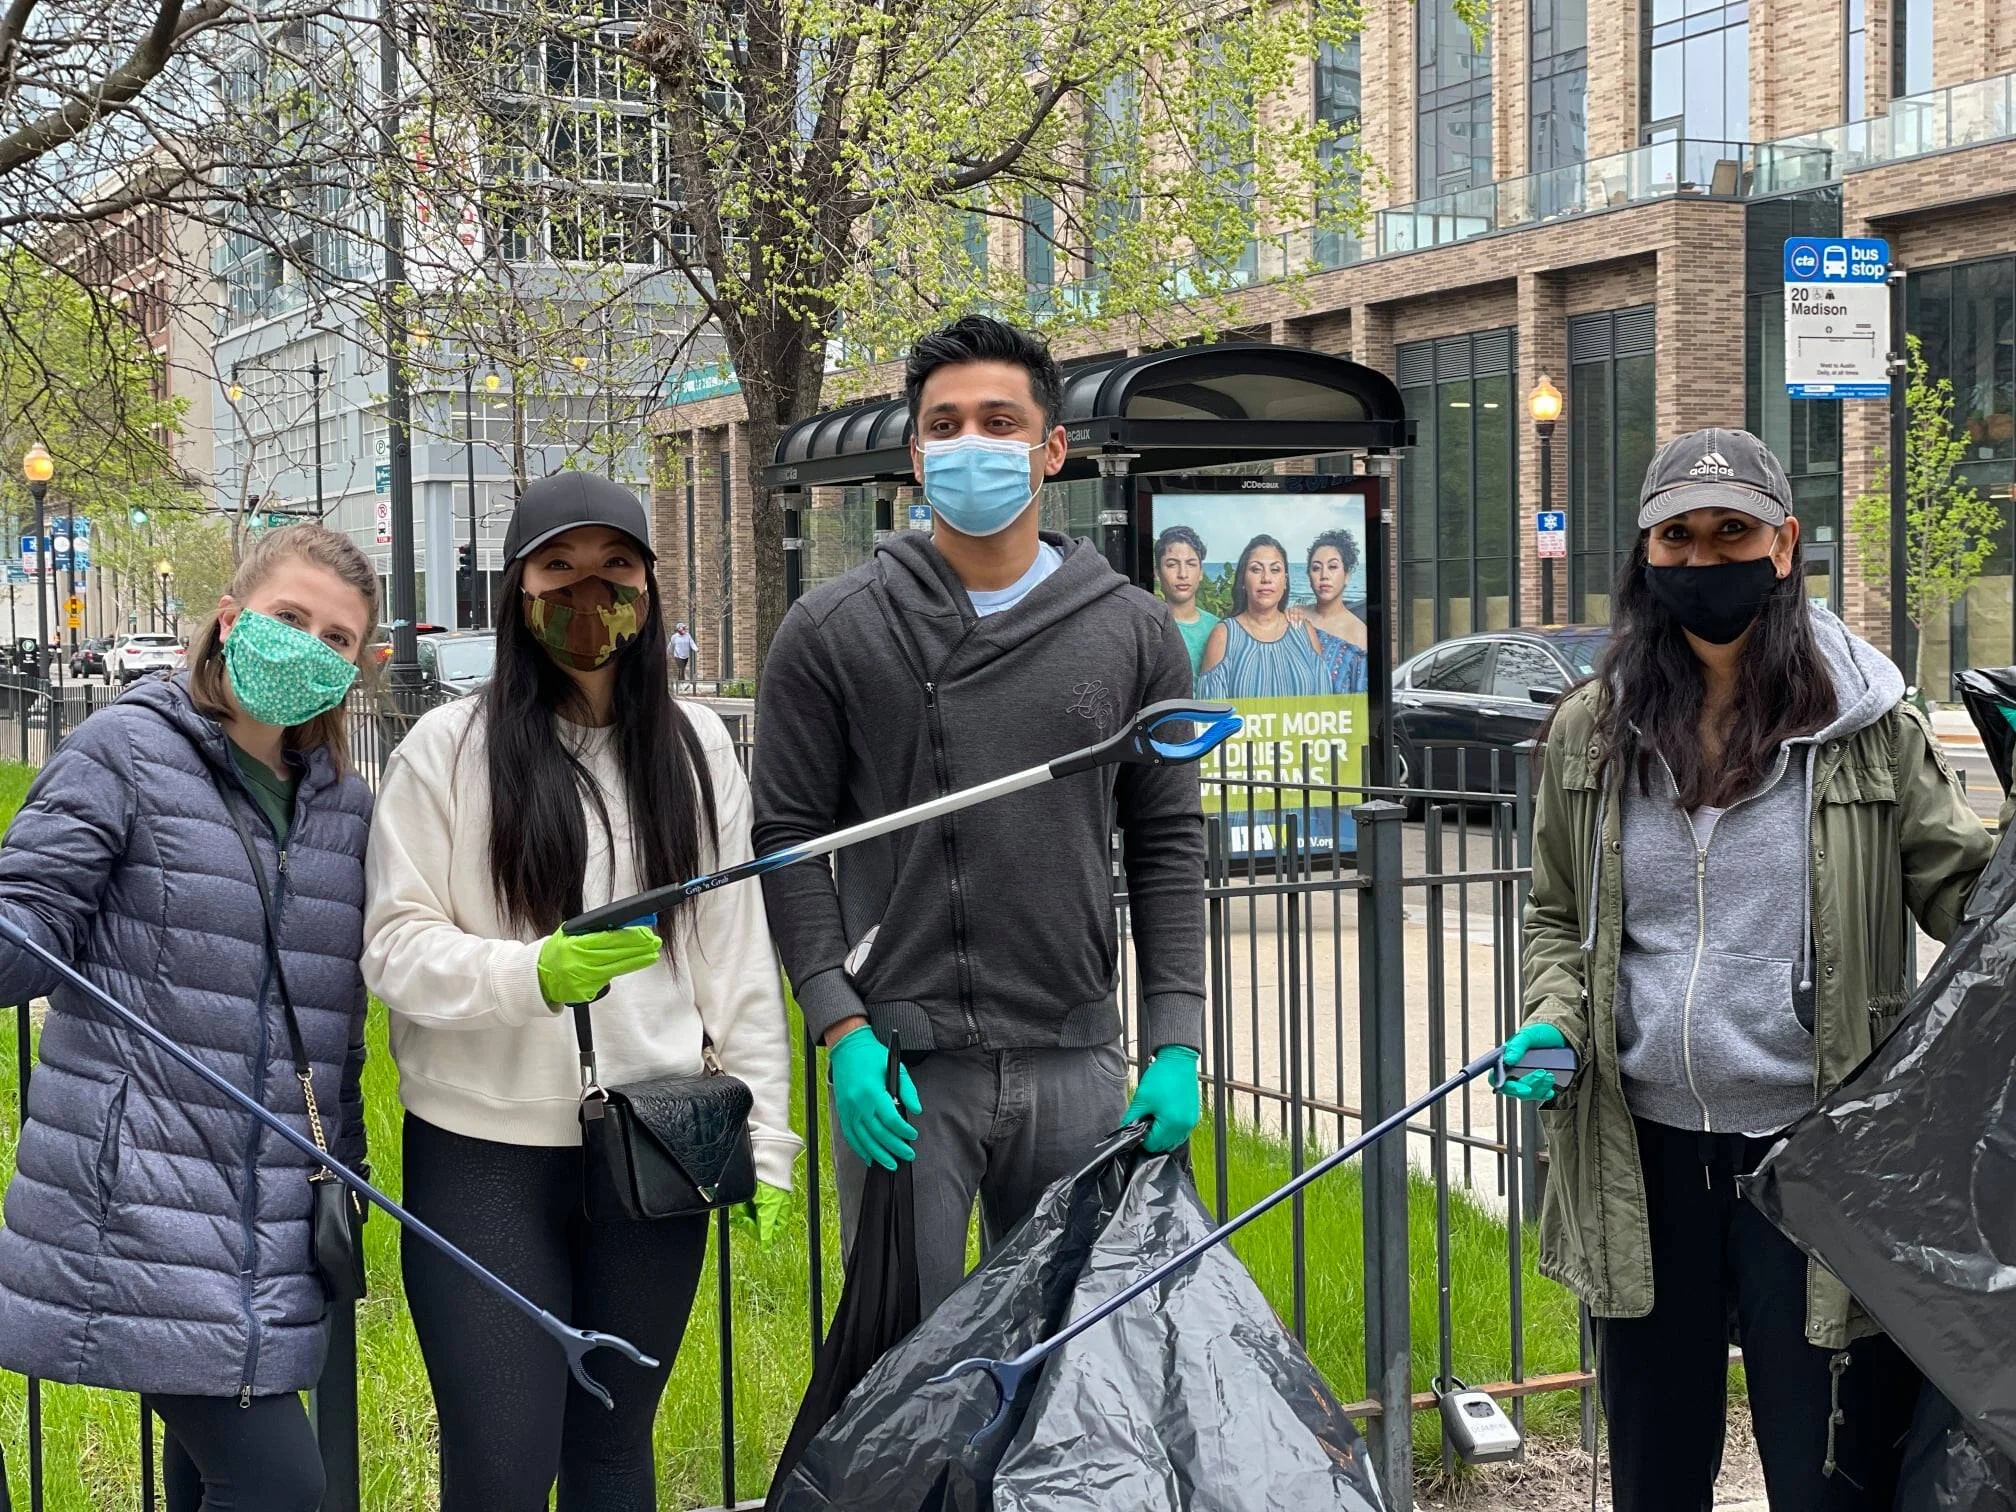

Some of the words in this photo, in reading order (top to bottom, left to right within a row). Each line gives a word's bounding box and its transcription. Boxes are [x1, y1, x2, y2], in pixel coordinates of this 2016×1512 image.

[1851, 245, 1879, 261] bus
[1795, 255, 1815, 266] cta
[1851, 262, 1885, 280] stop
[1791, 288, 1809, 301] 20
[1791, 302, 1847, 316] Madison
[1066, 428, 1091, 442] ecaux
[1689, 463, 1735, 477] adidas
[1241, 480, 1280, 489] JCDecaux
[1282, 710, 1353, 737] MORE
[1200, 740, 1294, 769] TORIES
[1301, 738, 1349, 763] FOR
[1297, 836, 1334, 849] DV.org
